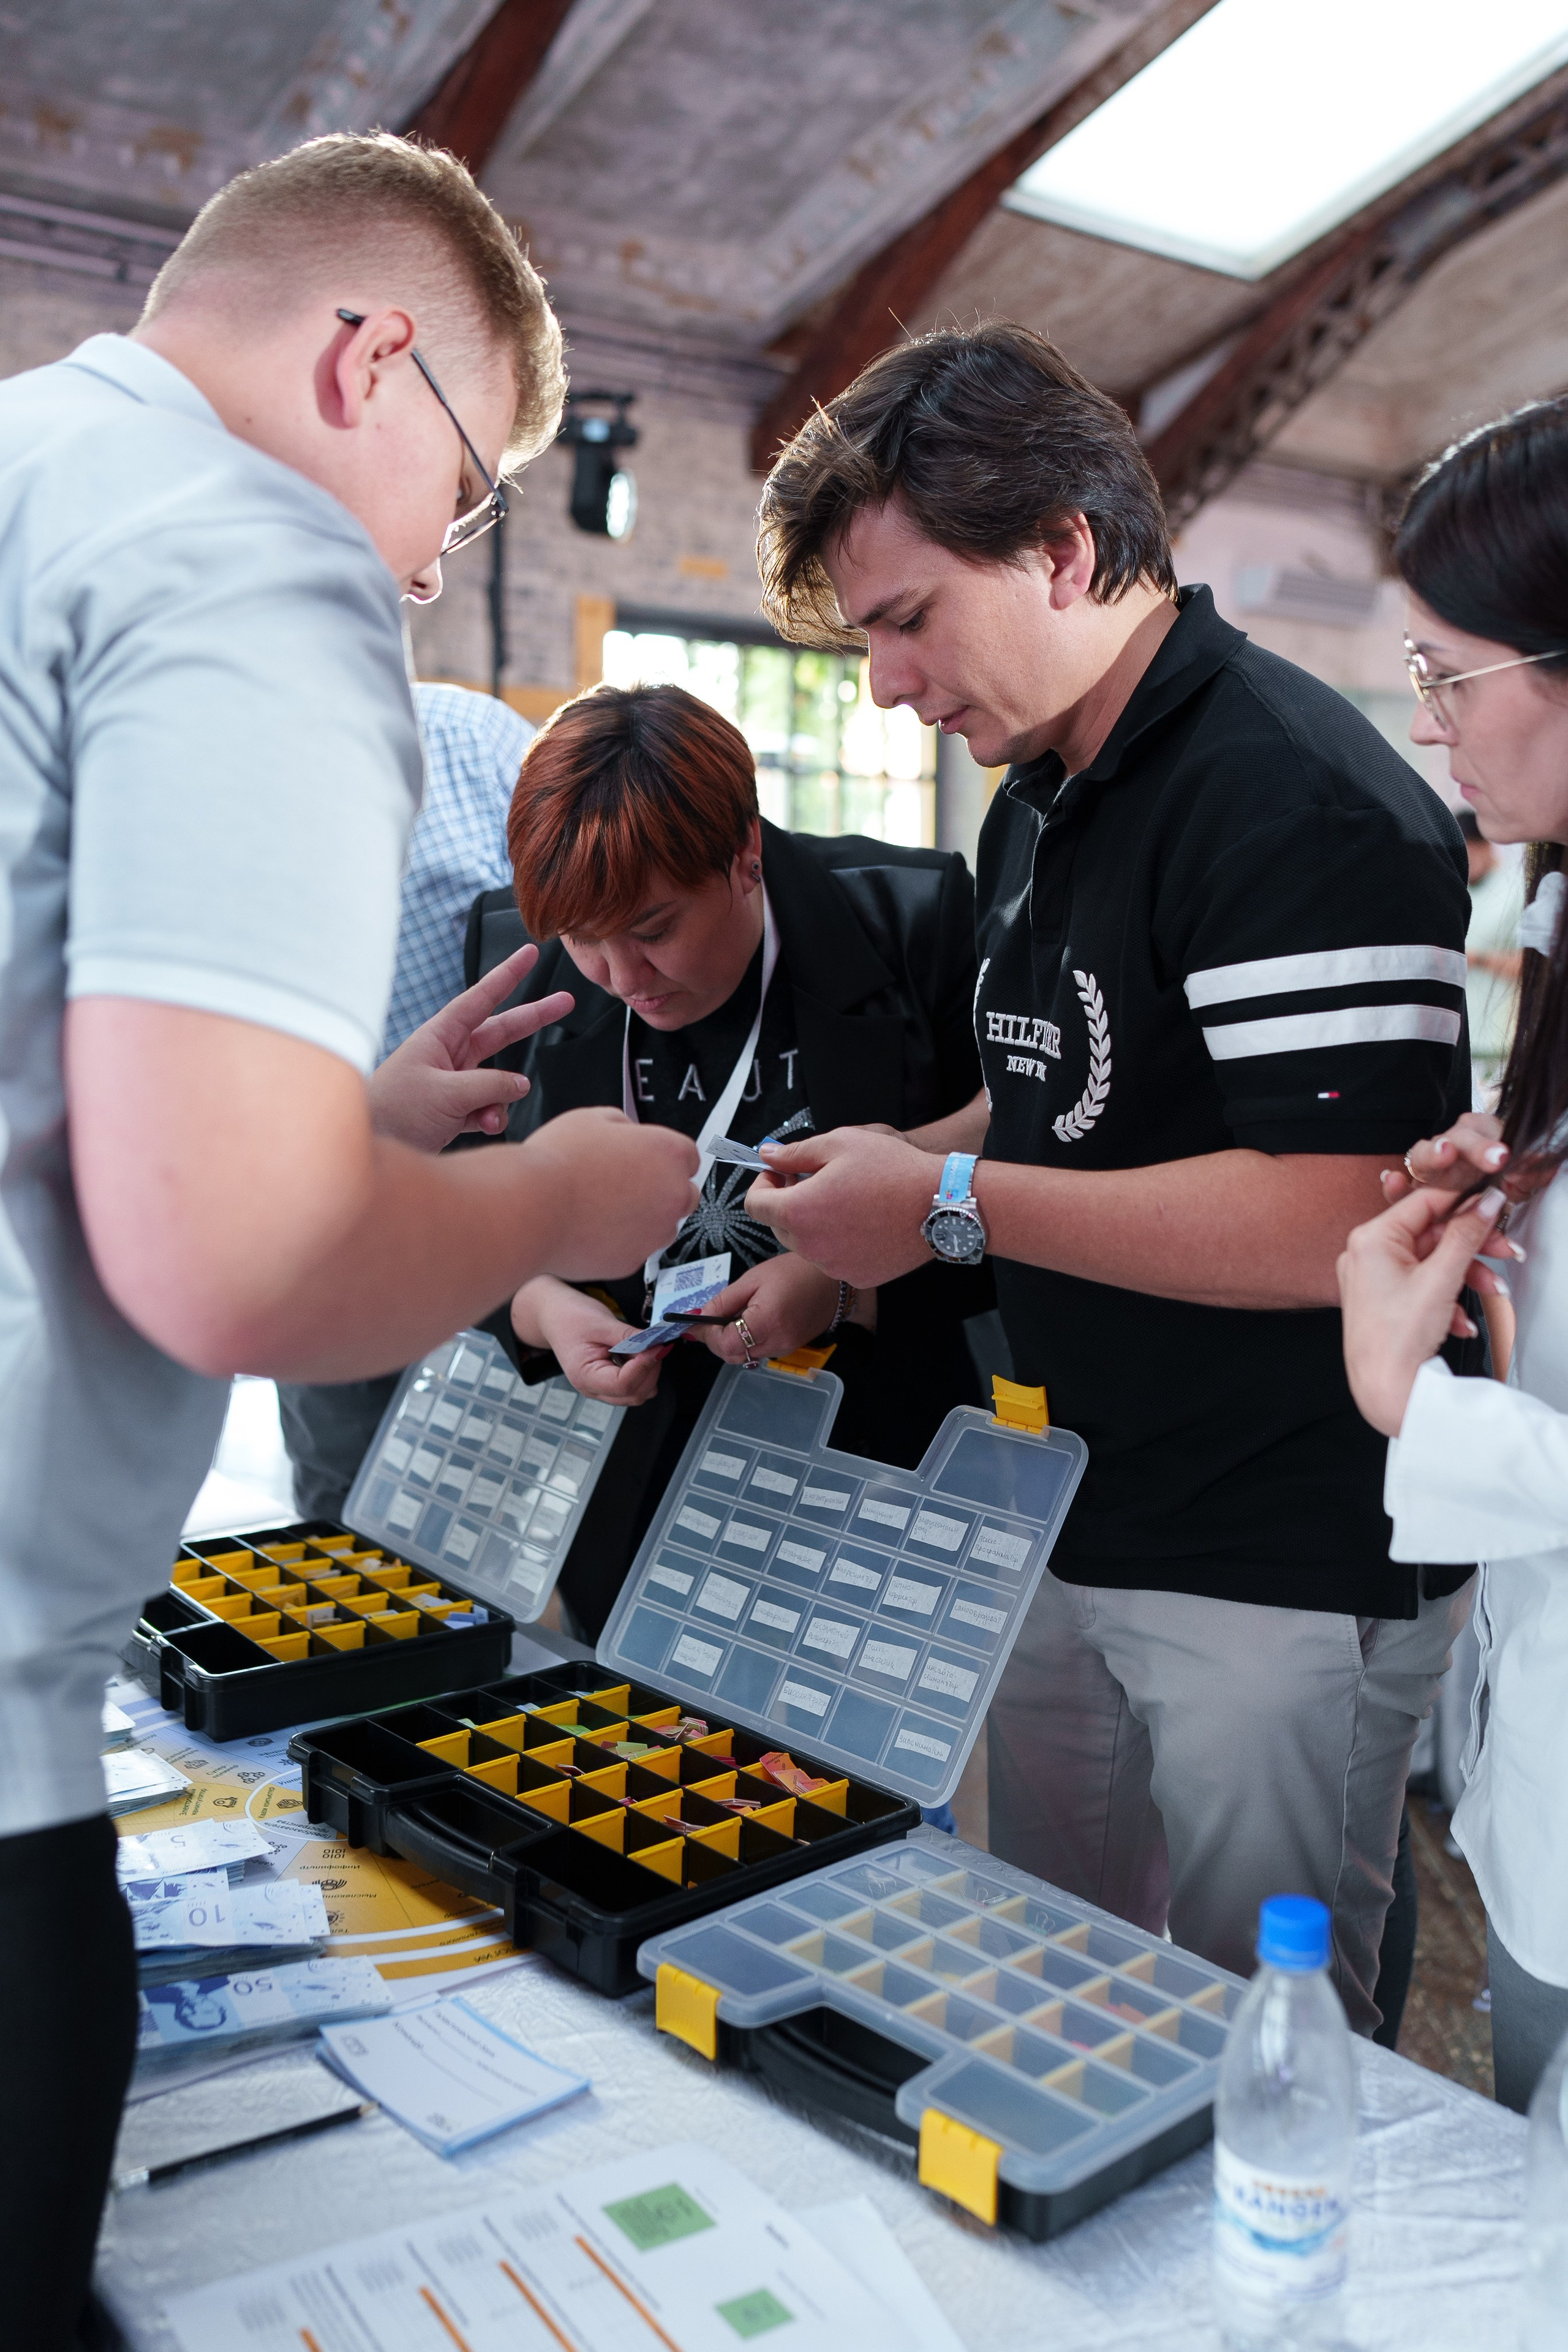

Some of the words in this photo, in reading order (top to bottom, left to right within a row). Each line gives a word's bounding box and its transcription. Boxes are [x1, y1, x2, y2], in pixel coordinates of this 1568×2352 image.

[986, 1011, 1061, 1060] HILFIER
[1006, 1055, 1037, 1077] NEW
[263, 1821, 332, 1840] Преобразователь
[276, 1819, 330, 1834] пространства
[170, 1834, 186, 1848] 5
[189, 1904, 226, 1927] 10
[233, 1977, 273, 1996] 50
